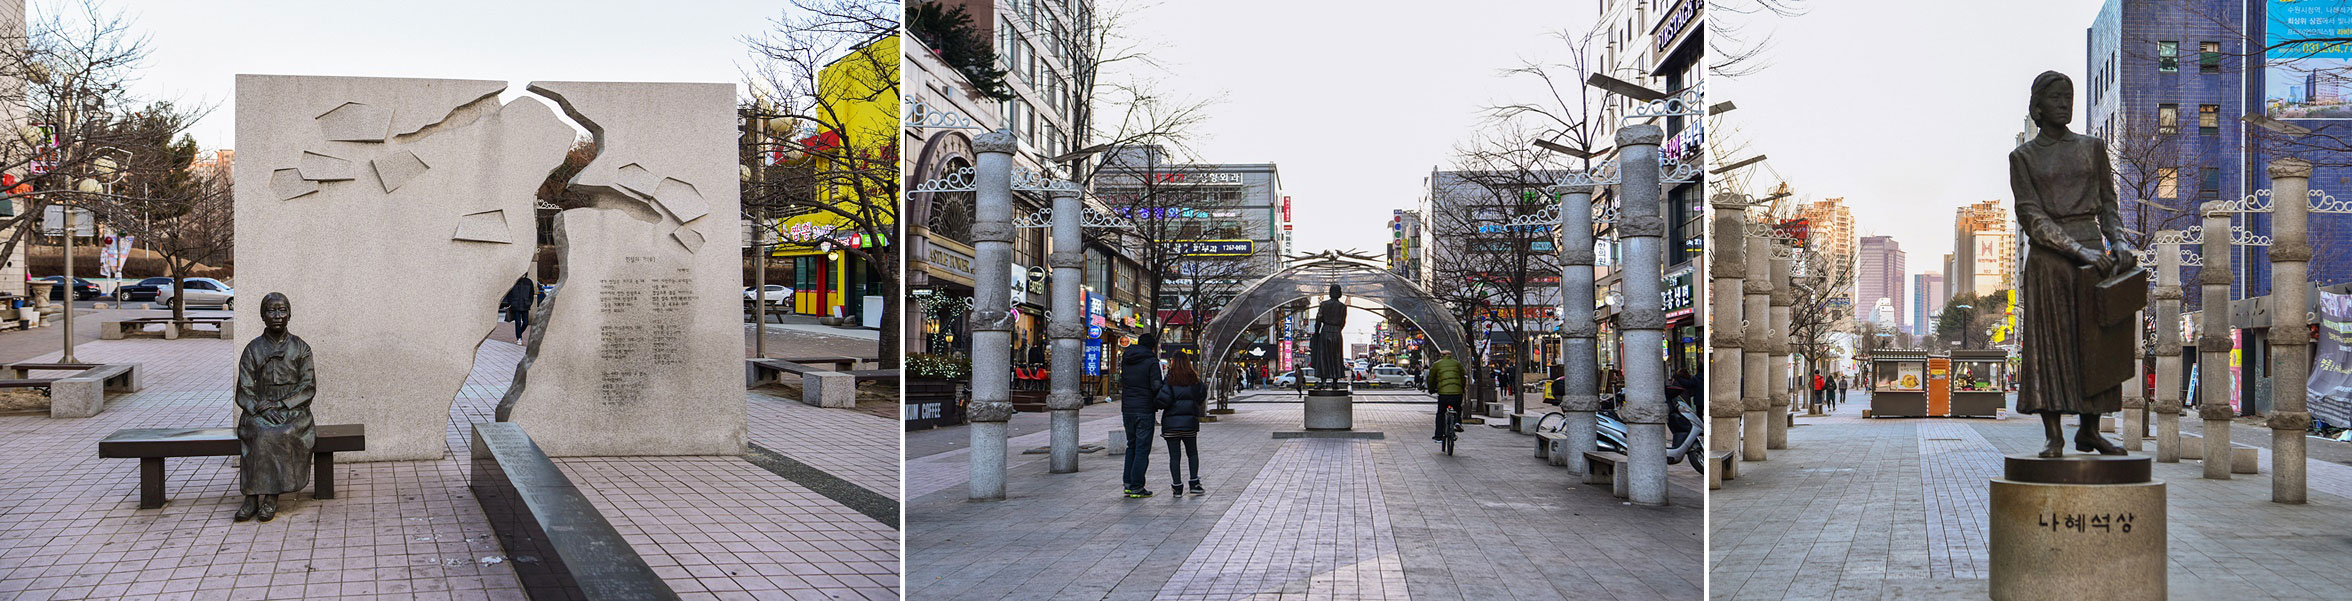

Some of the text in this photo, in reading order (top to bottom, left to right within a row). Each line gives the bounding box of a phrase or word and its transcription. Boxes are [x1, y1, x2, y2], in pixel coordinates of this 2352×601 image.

[2288, 17, 2307, 25] 최상위
[2310, 17, 2335, 25] 상권에서
[921, 402, 941, 419] COFFEE
[2039, 512, 2135, 533] 나혜석상
